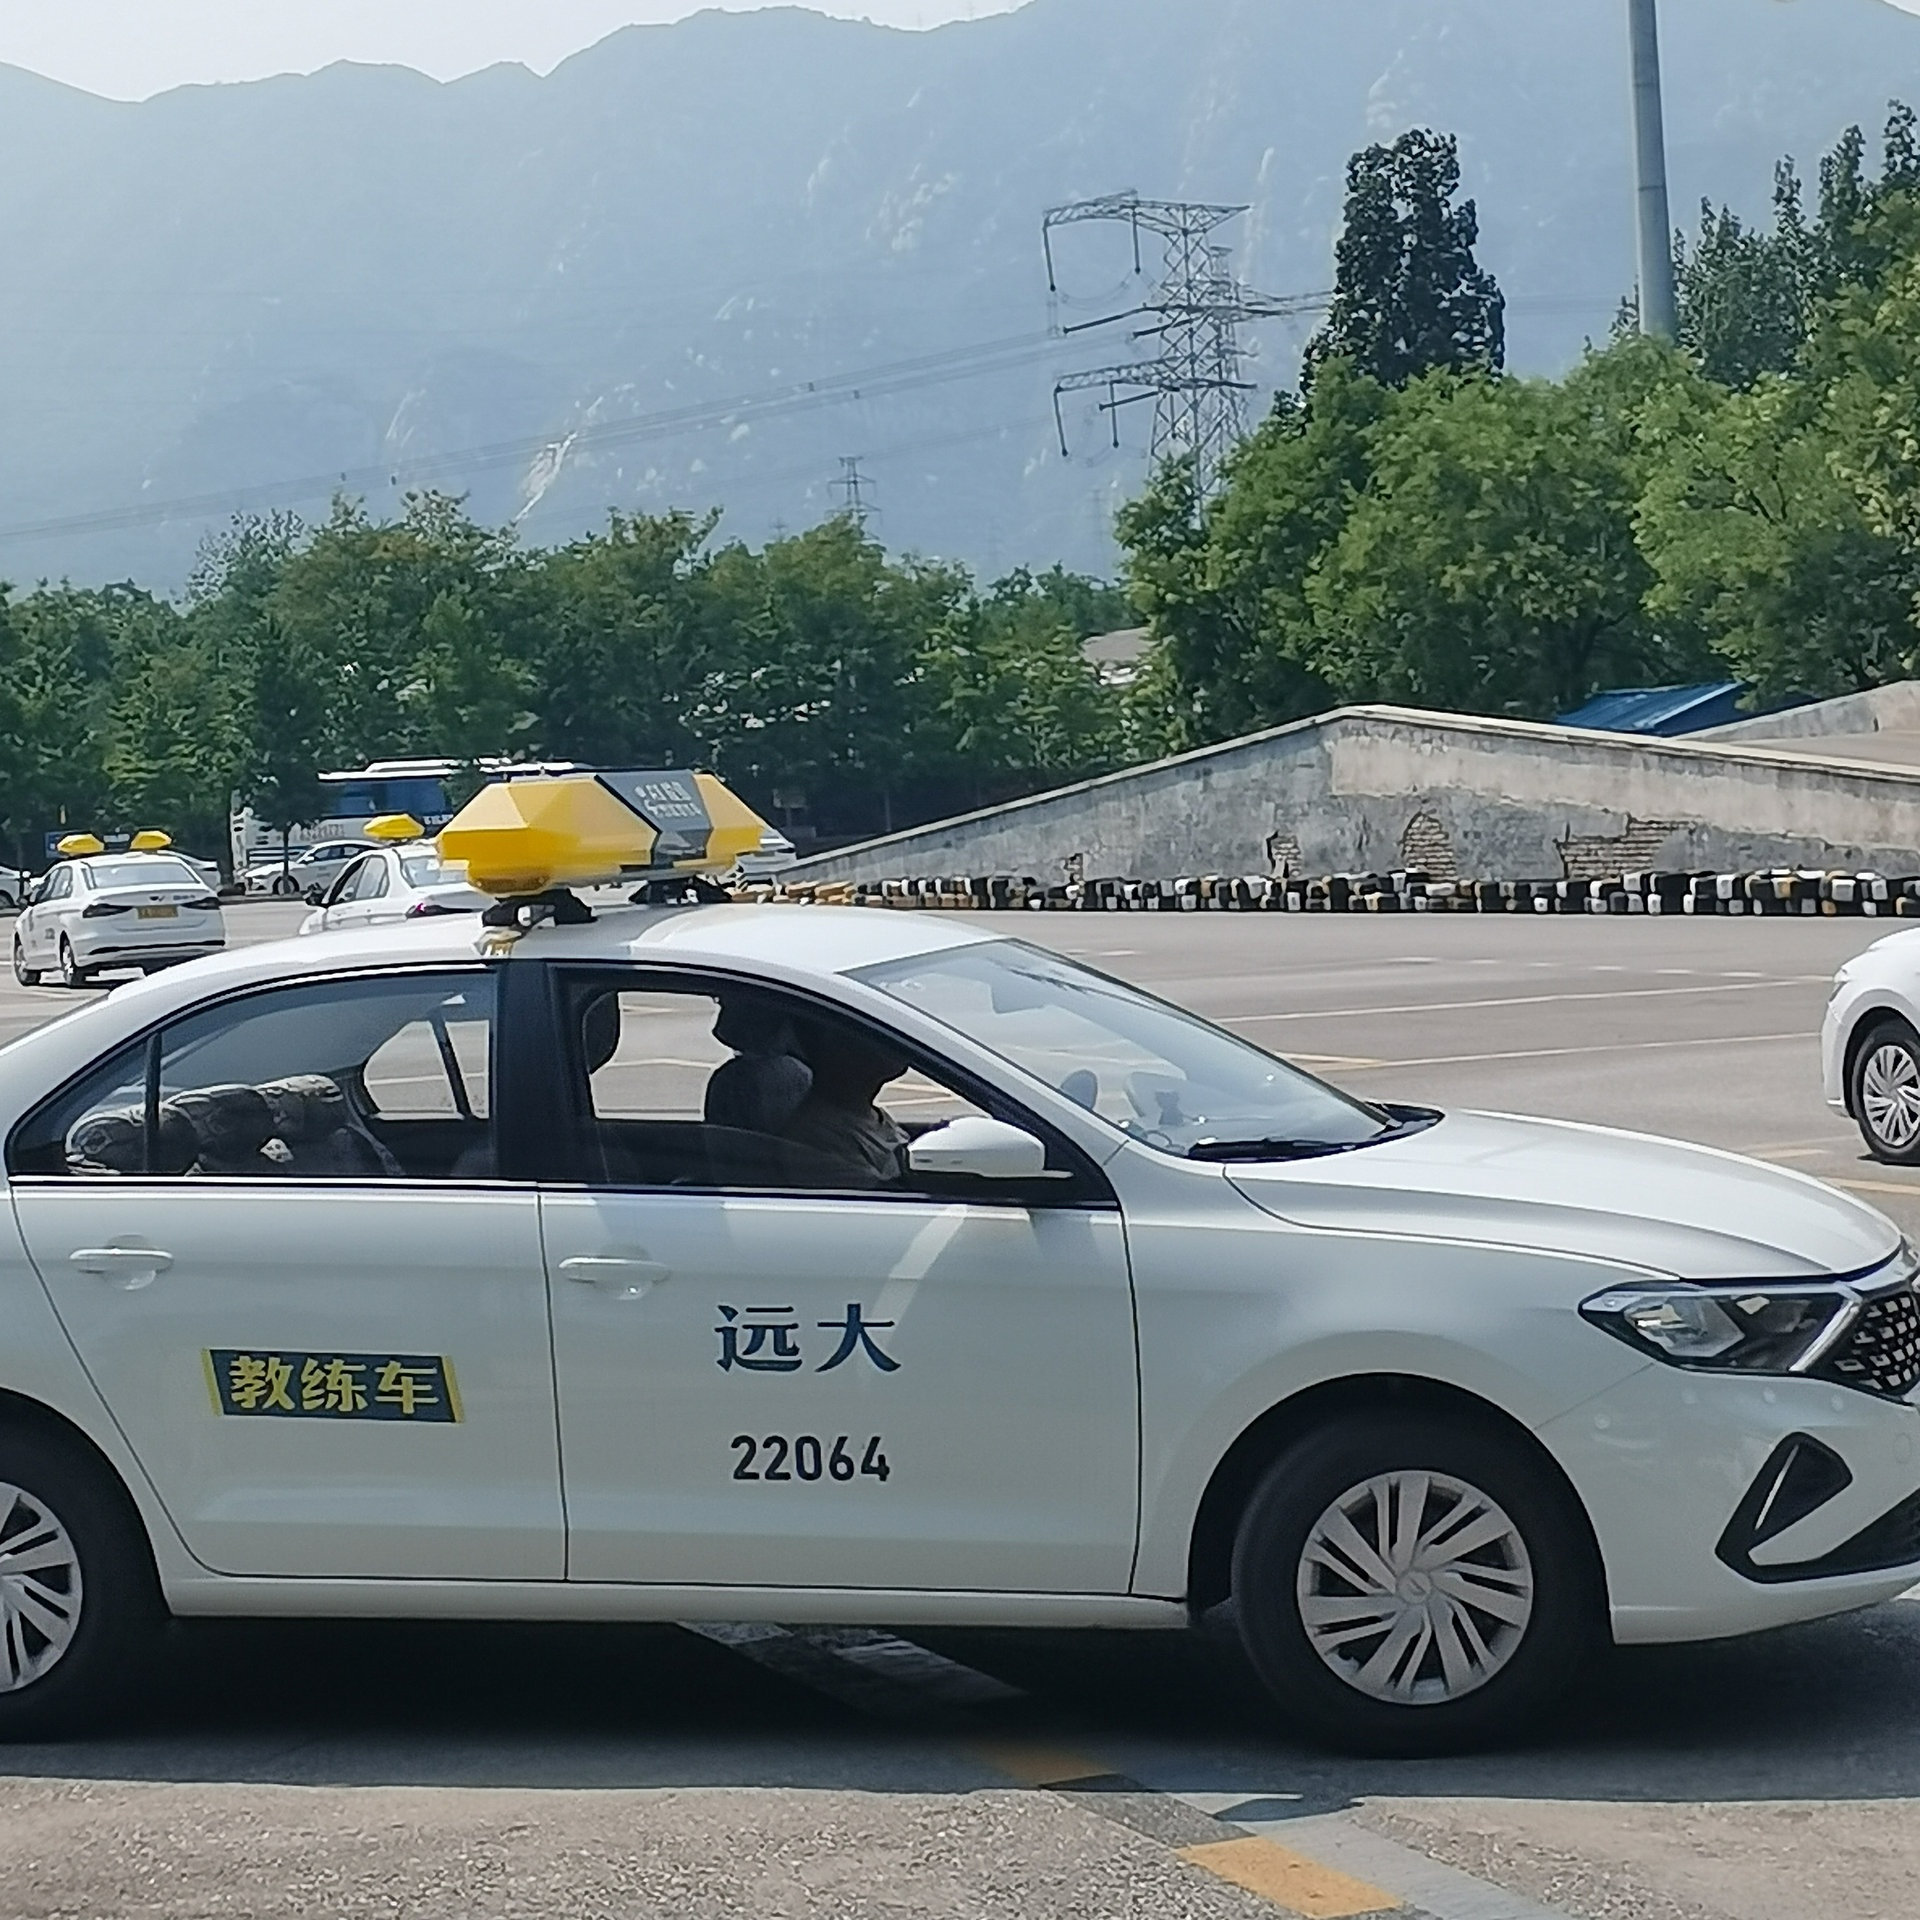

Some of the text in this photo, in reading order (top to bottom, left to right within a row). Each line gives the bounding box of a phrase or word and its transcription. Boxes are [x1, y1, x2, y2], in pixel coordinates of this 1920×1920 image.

[714, 1303, 901, 1373] 远大
[228, 1355, 440, 1415] 教练车
[730, 1435, 891, 1482] 22064
